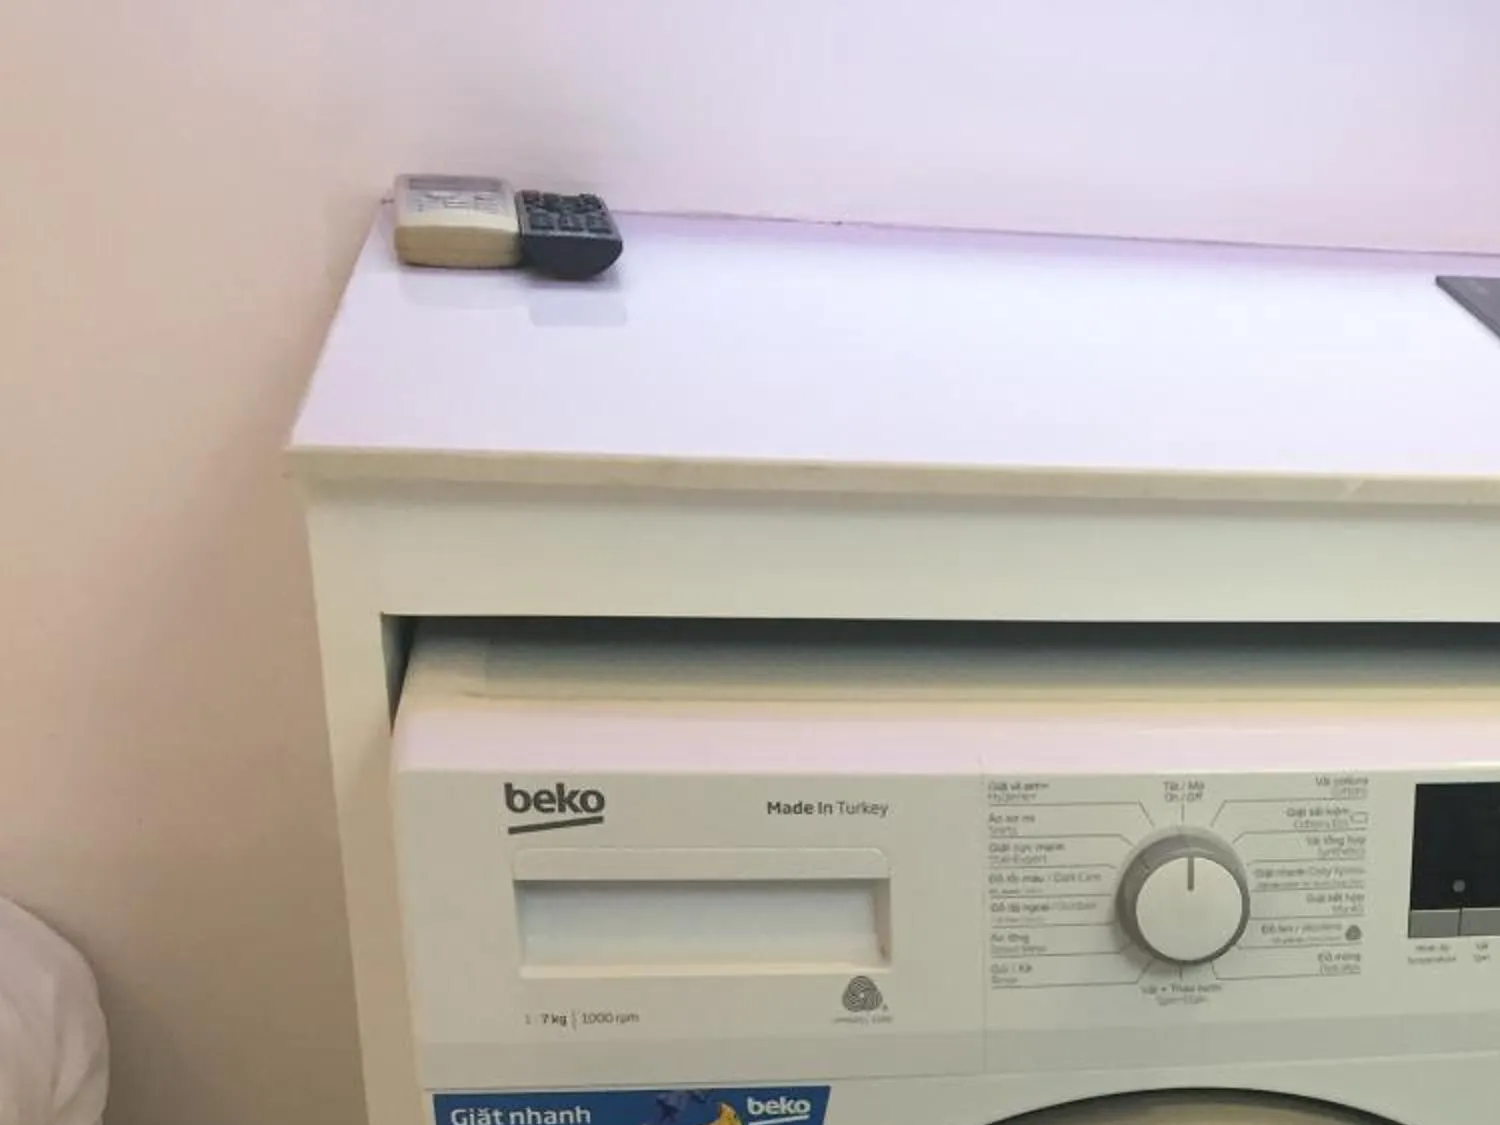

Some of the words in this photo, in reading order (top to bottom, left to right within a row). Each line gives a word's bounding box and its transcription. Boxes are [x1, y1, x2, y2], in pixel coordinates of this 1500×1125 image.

[503, 782, 606, 814] beko
[767, 800, 814, 815] Made
[817, 801, 833, 815] In
[836, 800, 889, 818] Turkey
[551, 1012, 567, 1028] kg
[581, 1011, 615, 1026] 1000
[615, 1012, 640, 1026] rpm
[508, 1105, 592, 1125] nhanh
[746, 1096, 811, 1116] beko
